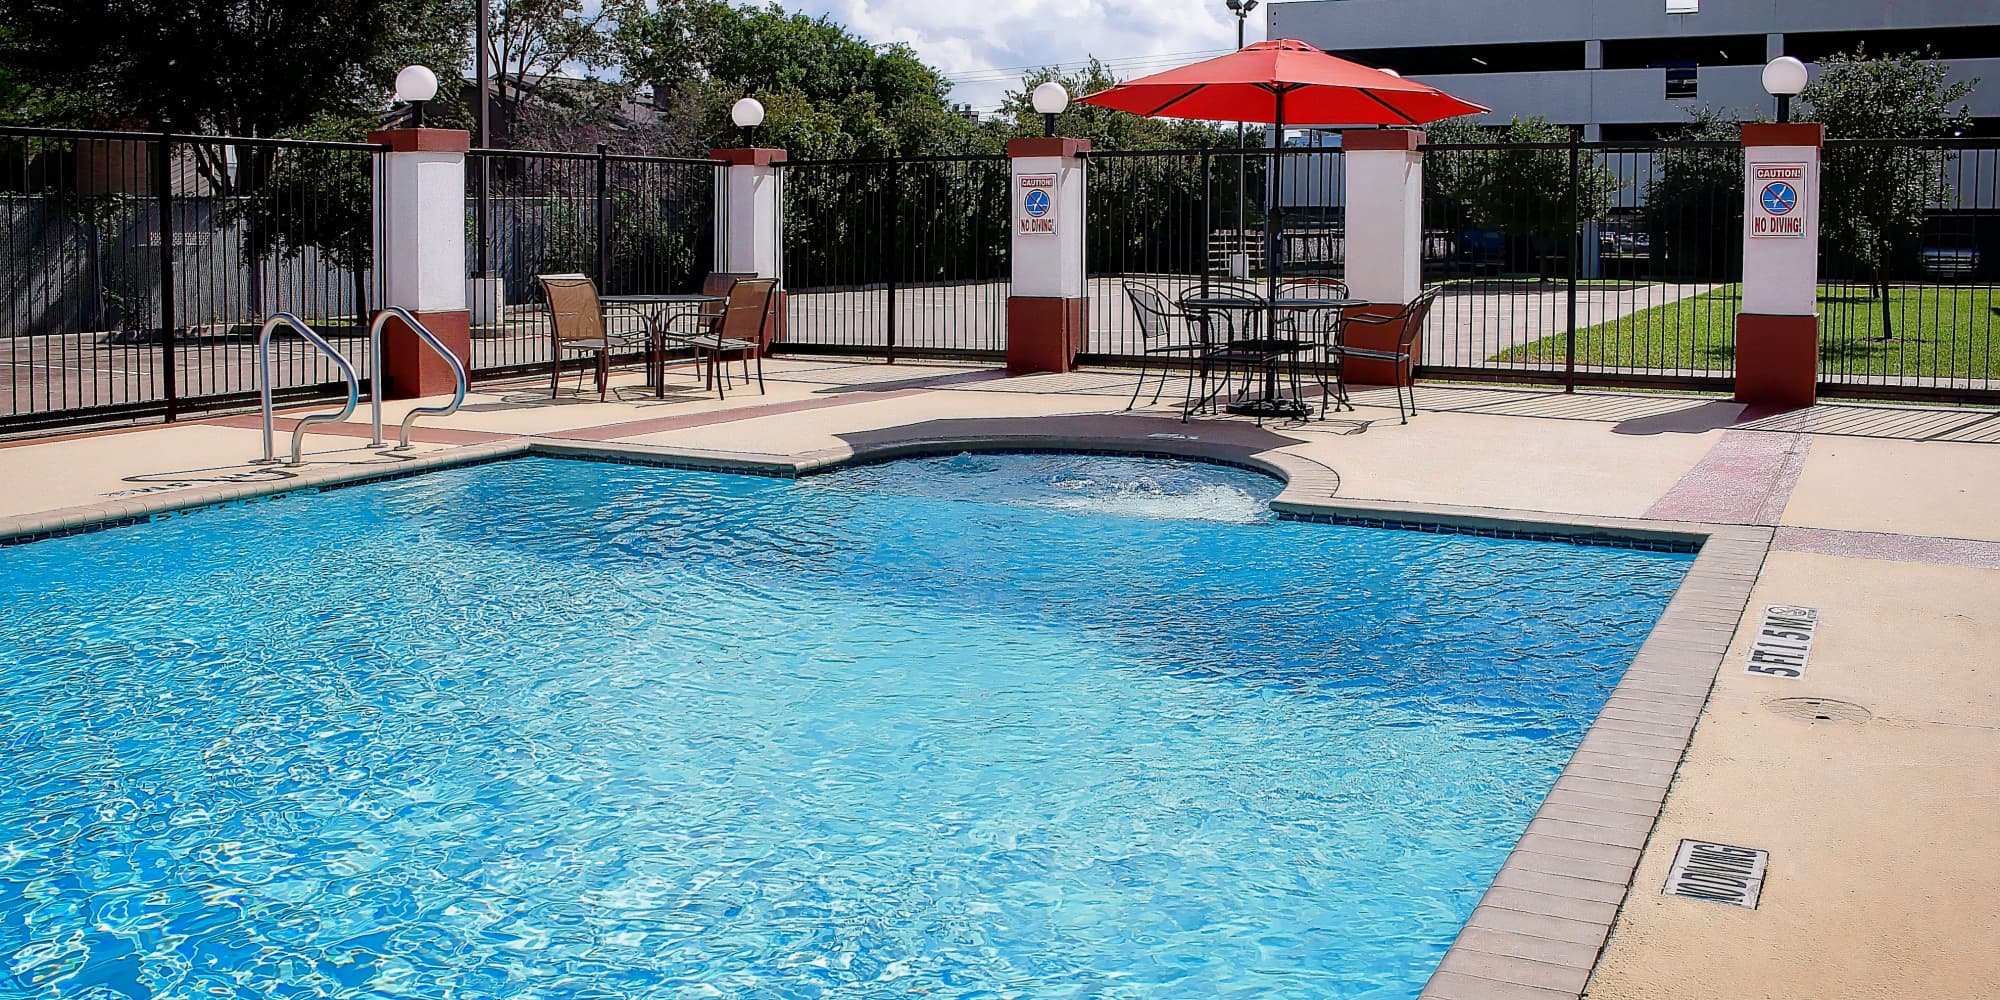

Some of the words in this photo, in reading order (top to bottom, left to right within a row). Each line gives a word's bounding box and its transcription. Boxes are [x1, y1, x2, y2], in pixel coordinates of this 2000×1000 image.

[1757, 169, 1801, 178] CAUTION!
[1021, 219, 1030, 232] NO
[1032, 219, 1054, 232] DIVING!
[1755, 217, 1767, 233] NO
[1770, 217, 1802, 233] DIVING!
[1681, 844, 1757, 889] DIVING
[1675, 882, 1746, 906] NO
